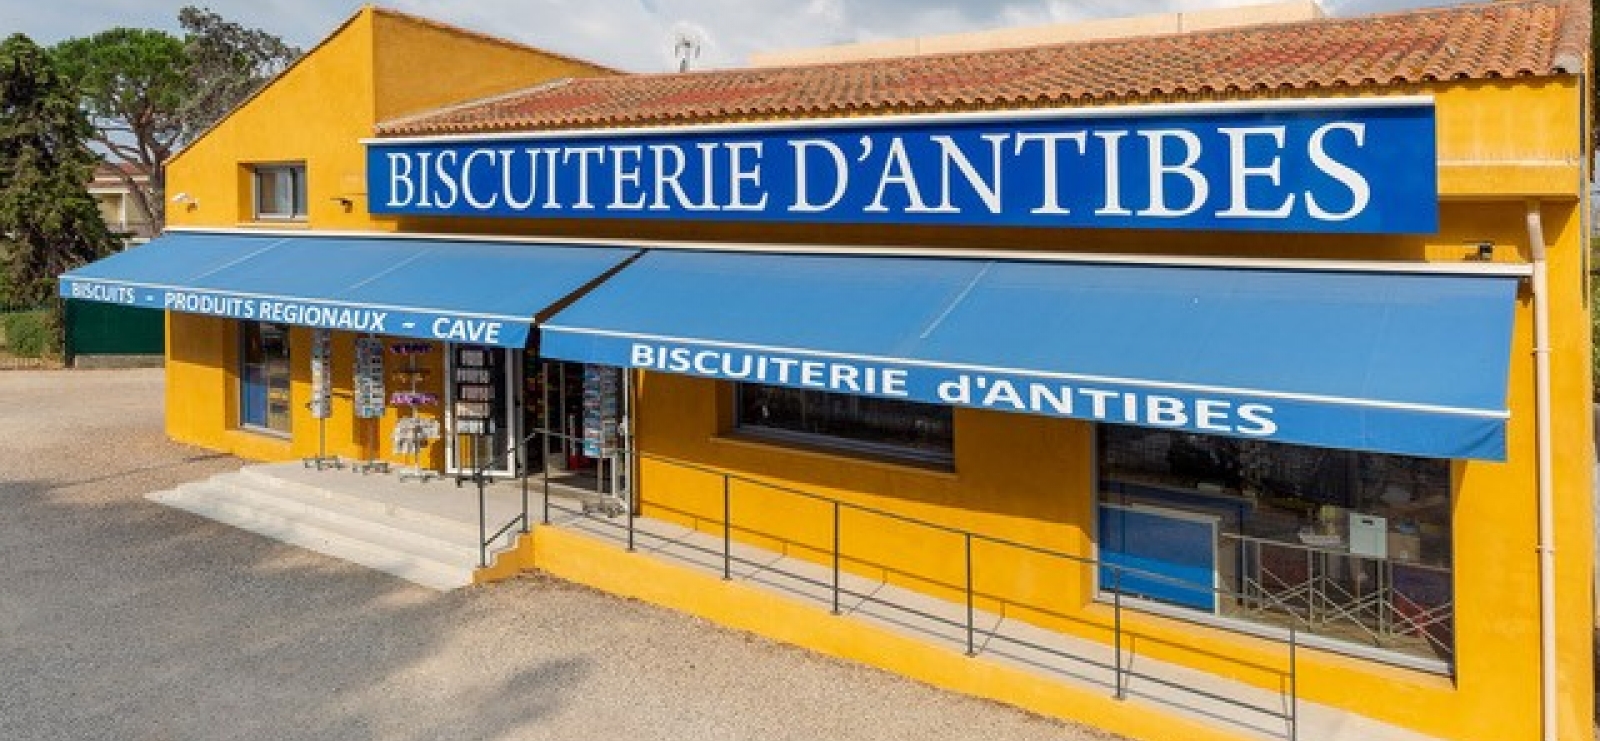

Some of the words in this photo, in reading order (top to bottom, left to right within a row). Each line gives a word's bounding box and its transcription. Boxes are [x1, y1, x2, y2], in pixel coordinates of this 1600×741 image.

[386, 142, 768, 211] BISCUITERIE
[787, 122, 1370, 222] D’ANTIBES
[71, 282, 134, 304] BISCUITS
[164, 292, 254, 318] PRODUITS
[259, 301, 387, 331] REGIONAUX
[432, 317, 502, 344] CAVE
[631, 343, 909, 396] BISCUITERIE
[937, 374, 1278, 436] d'ANTIBES
